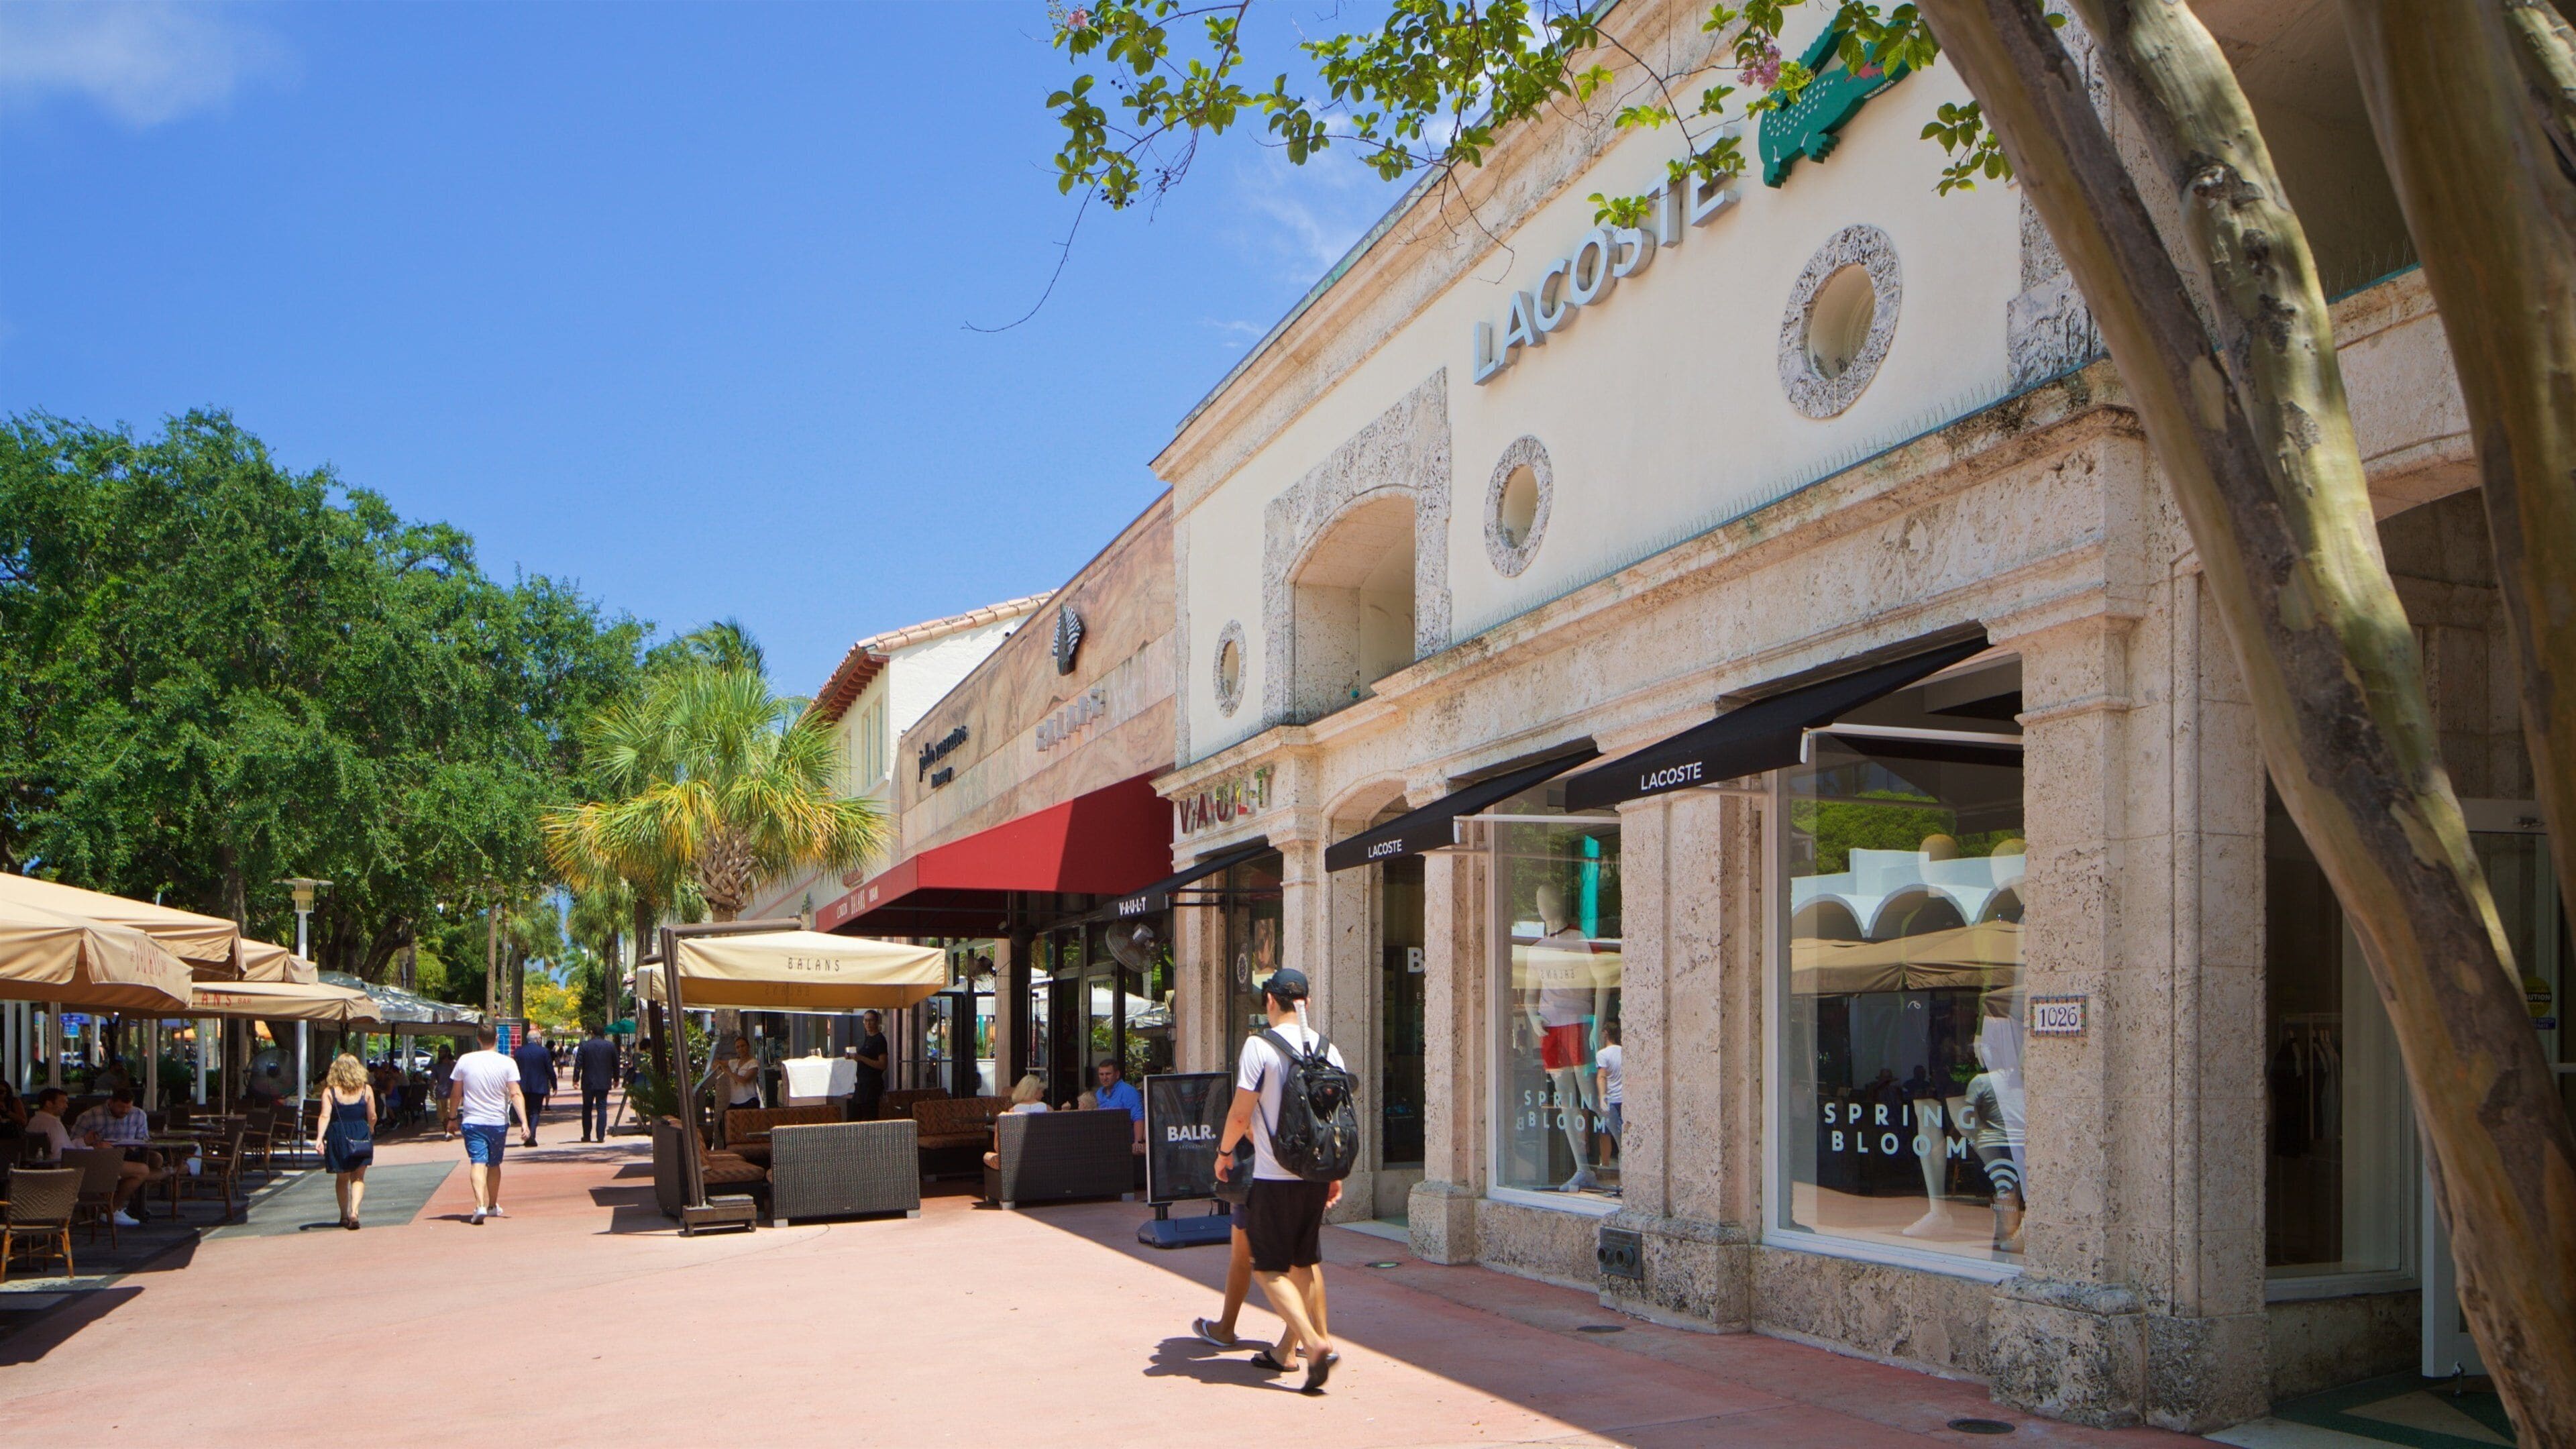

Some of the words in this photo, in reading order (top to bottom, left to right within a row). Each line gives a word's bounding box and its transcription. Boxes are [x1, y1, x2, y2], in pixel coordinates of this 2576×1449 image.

[1641, 761, 1703, 790] LACOSTE
[1368, 839, 1402, 858] LACOSTE
[788, 957, 840, 972] BALANS
[2040, 1006, 2078, 1027] 1026
[1824, 1102, 1976, 1130] SPRING
[1167, 1124, 1217, 1142] BALR.
